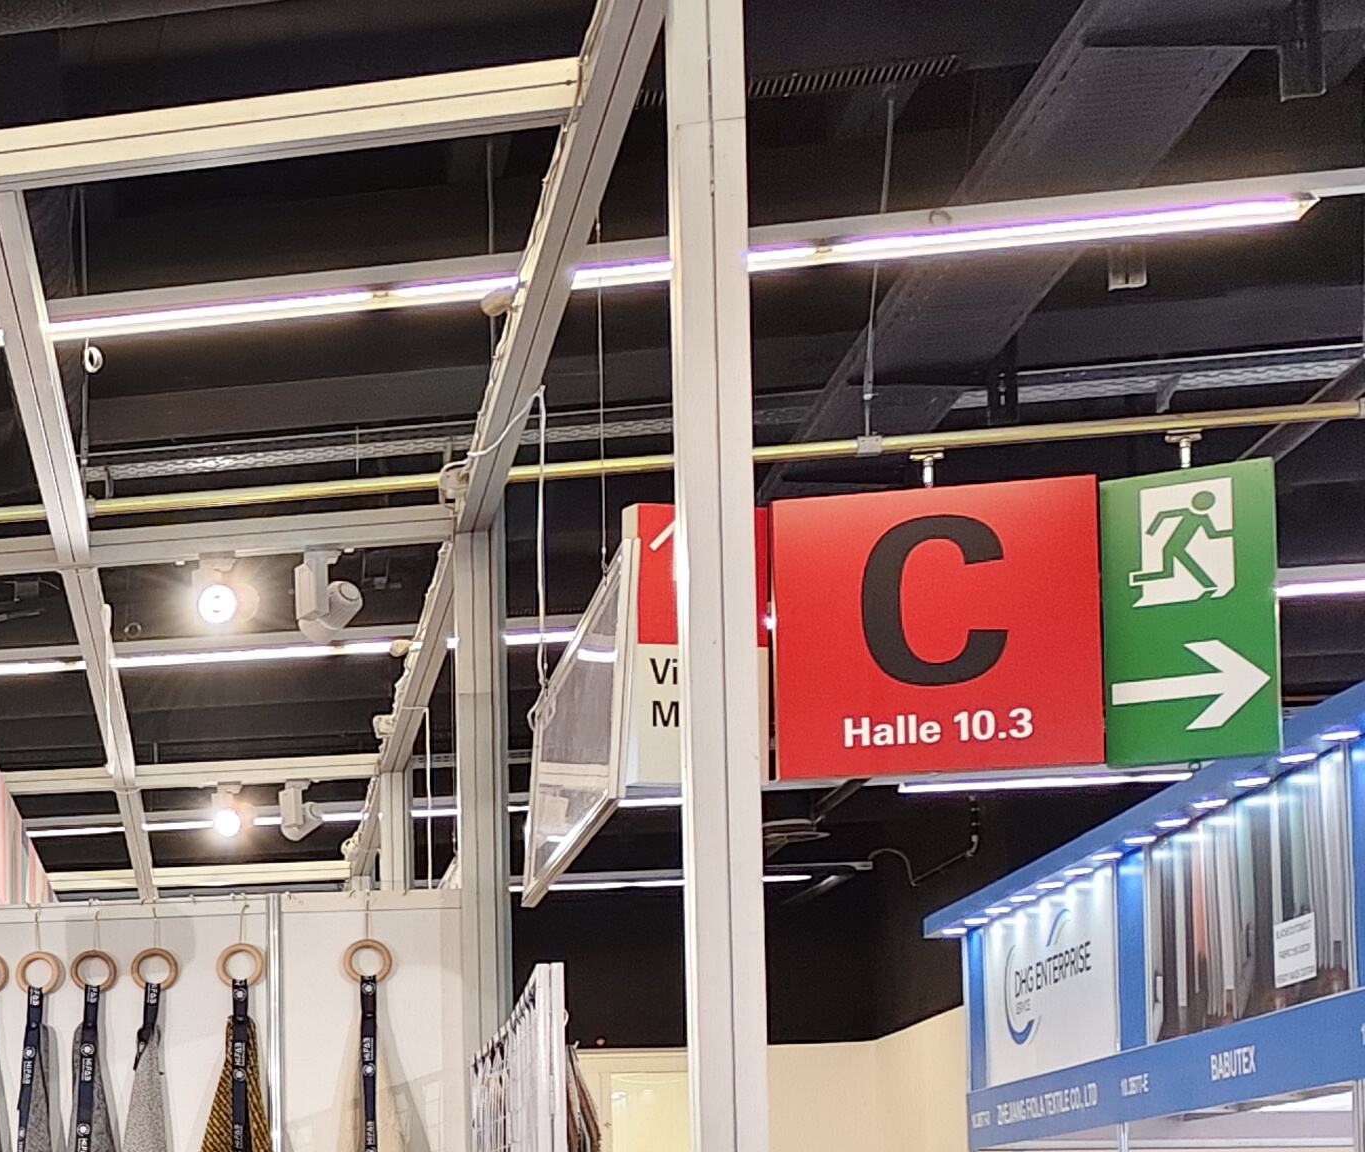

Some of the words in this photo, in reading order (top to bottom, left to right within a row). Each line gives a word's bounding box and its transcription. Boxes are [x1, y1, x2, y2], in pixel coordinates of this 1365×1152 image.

[861, 514, 1009, 687] C
[649, 657, 679, 685] Vi
[843, 713, 942, 748] Halle
[952, 707, 1033, 742] 10.3
[1014, 965, 1034, 998] DHG
[1035, 941, 1092, 990] ENTERPRISE
[1210, 1045, 1257, 1081] BABUTEX
